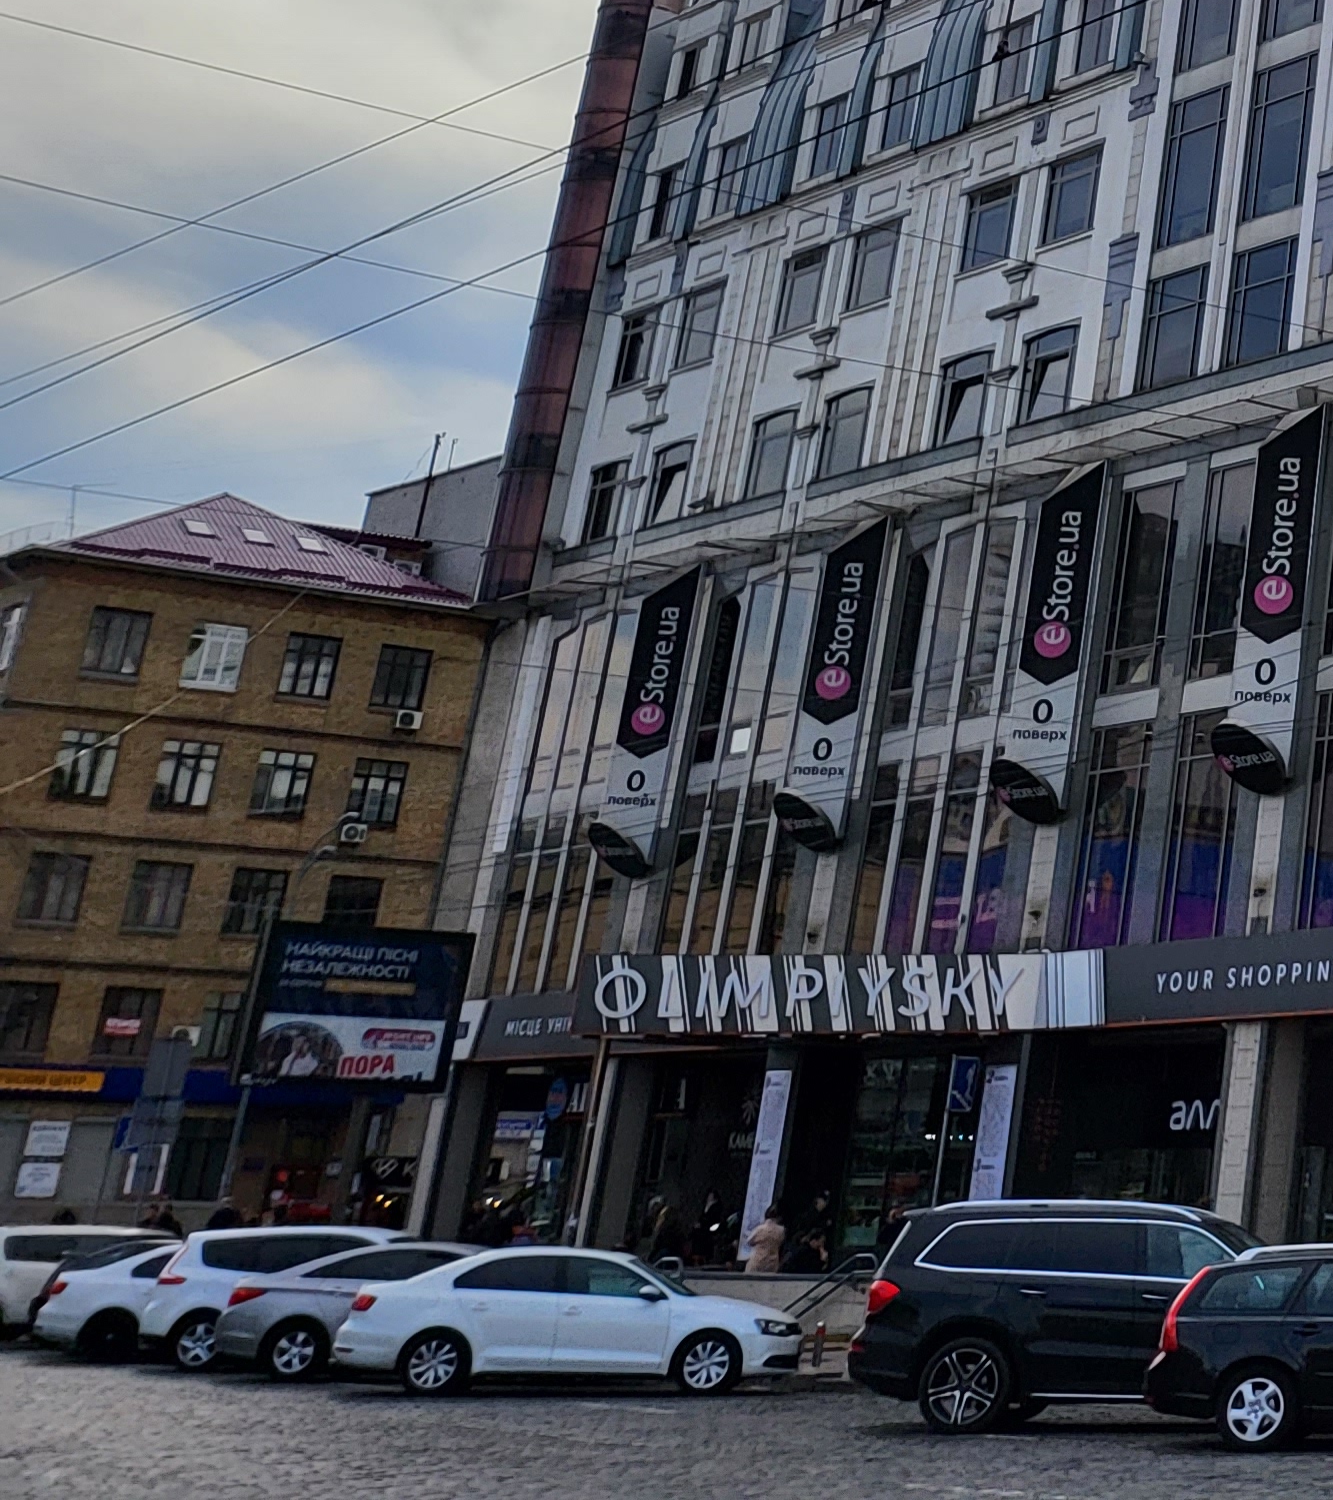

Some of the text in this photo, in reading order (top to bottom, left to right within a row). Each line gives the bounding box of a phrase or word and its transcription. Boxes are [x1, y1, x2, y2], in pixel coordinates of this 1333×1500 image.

[1262, 457, 1301, 600] eStore.ua
[1042, 510, 1082, 645] eStore.ua
[824, 562, 864, 687] eStore.ua
[639, 606, 680, 724] eStore.ua
[1234, 689, 1292, 704] поверх
[1012, 728, 1067, 742] поверх
[793, 765, 845, 776] поверх
[607, 794, 656, 808] поверх
[594, 965, 1025, 1020] OLIMPIYSKY
[1156, 968, 1215, 994] YOUR
[504, 1019, 542, 1038] МІСЦЕ
[339, 1054, 395, 1076] ПОРА
